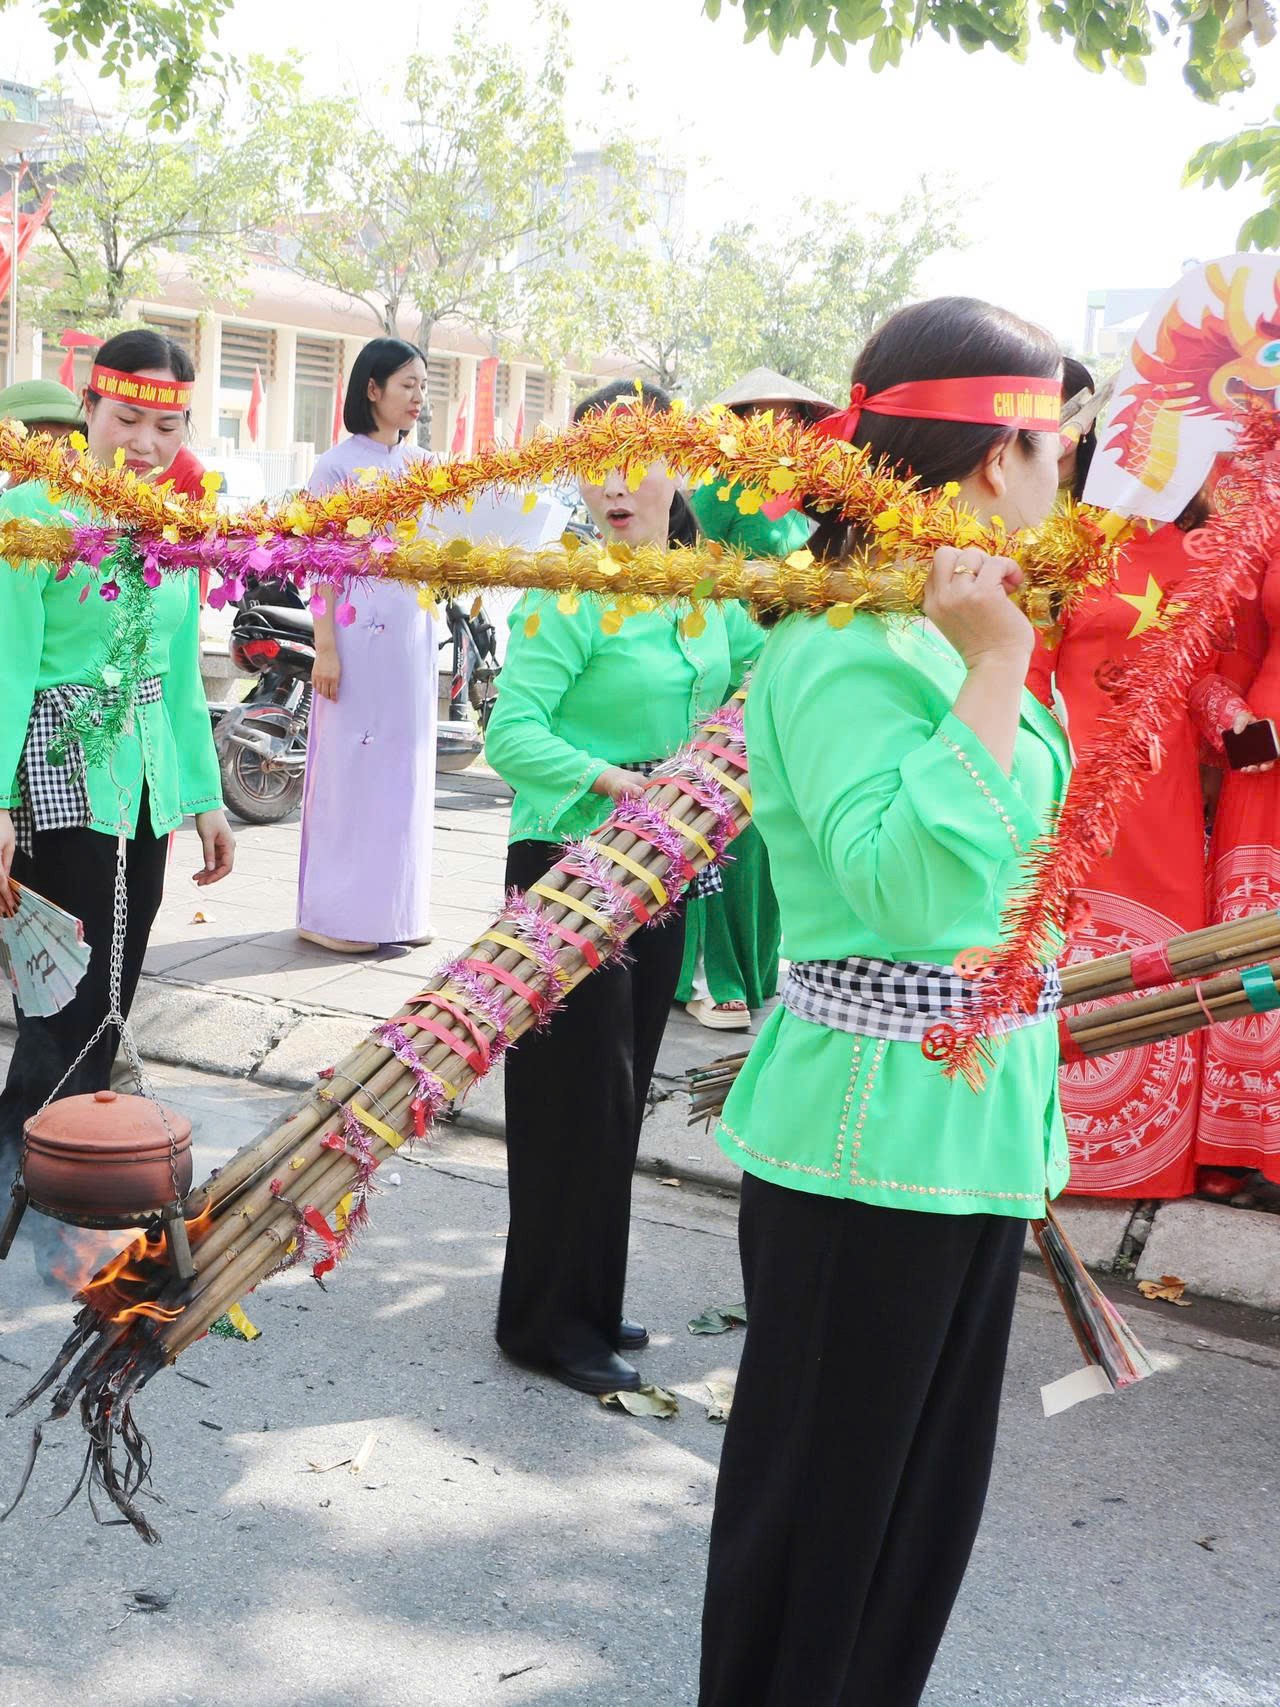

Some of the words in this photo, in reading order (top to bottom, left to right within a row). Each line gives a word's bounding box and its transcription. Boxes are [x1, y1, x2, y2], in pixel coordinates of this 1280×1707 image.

[106, 376, 118, 395] HỘI
[117, 379, 139, 399] NÔNG
[139, 383, 157, 402] DÂN
[157, 386, 176, 404] THÔN
[993, 392, 1015, 418] CHI
[1016, 387, 1033, 424] HỘI
